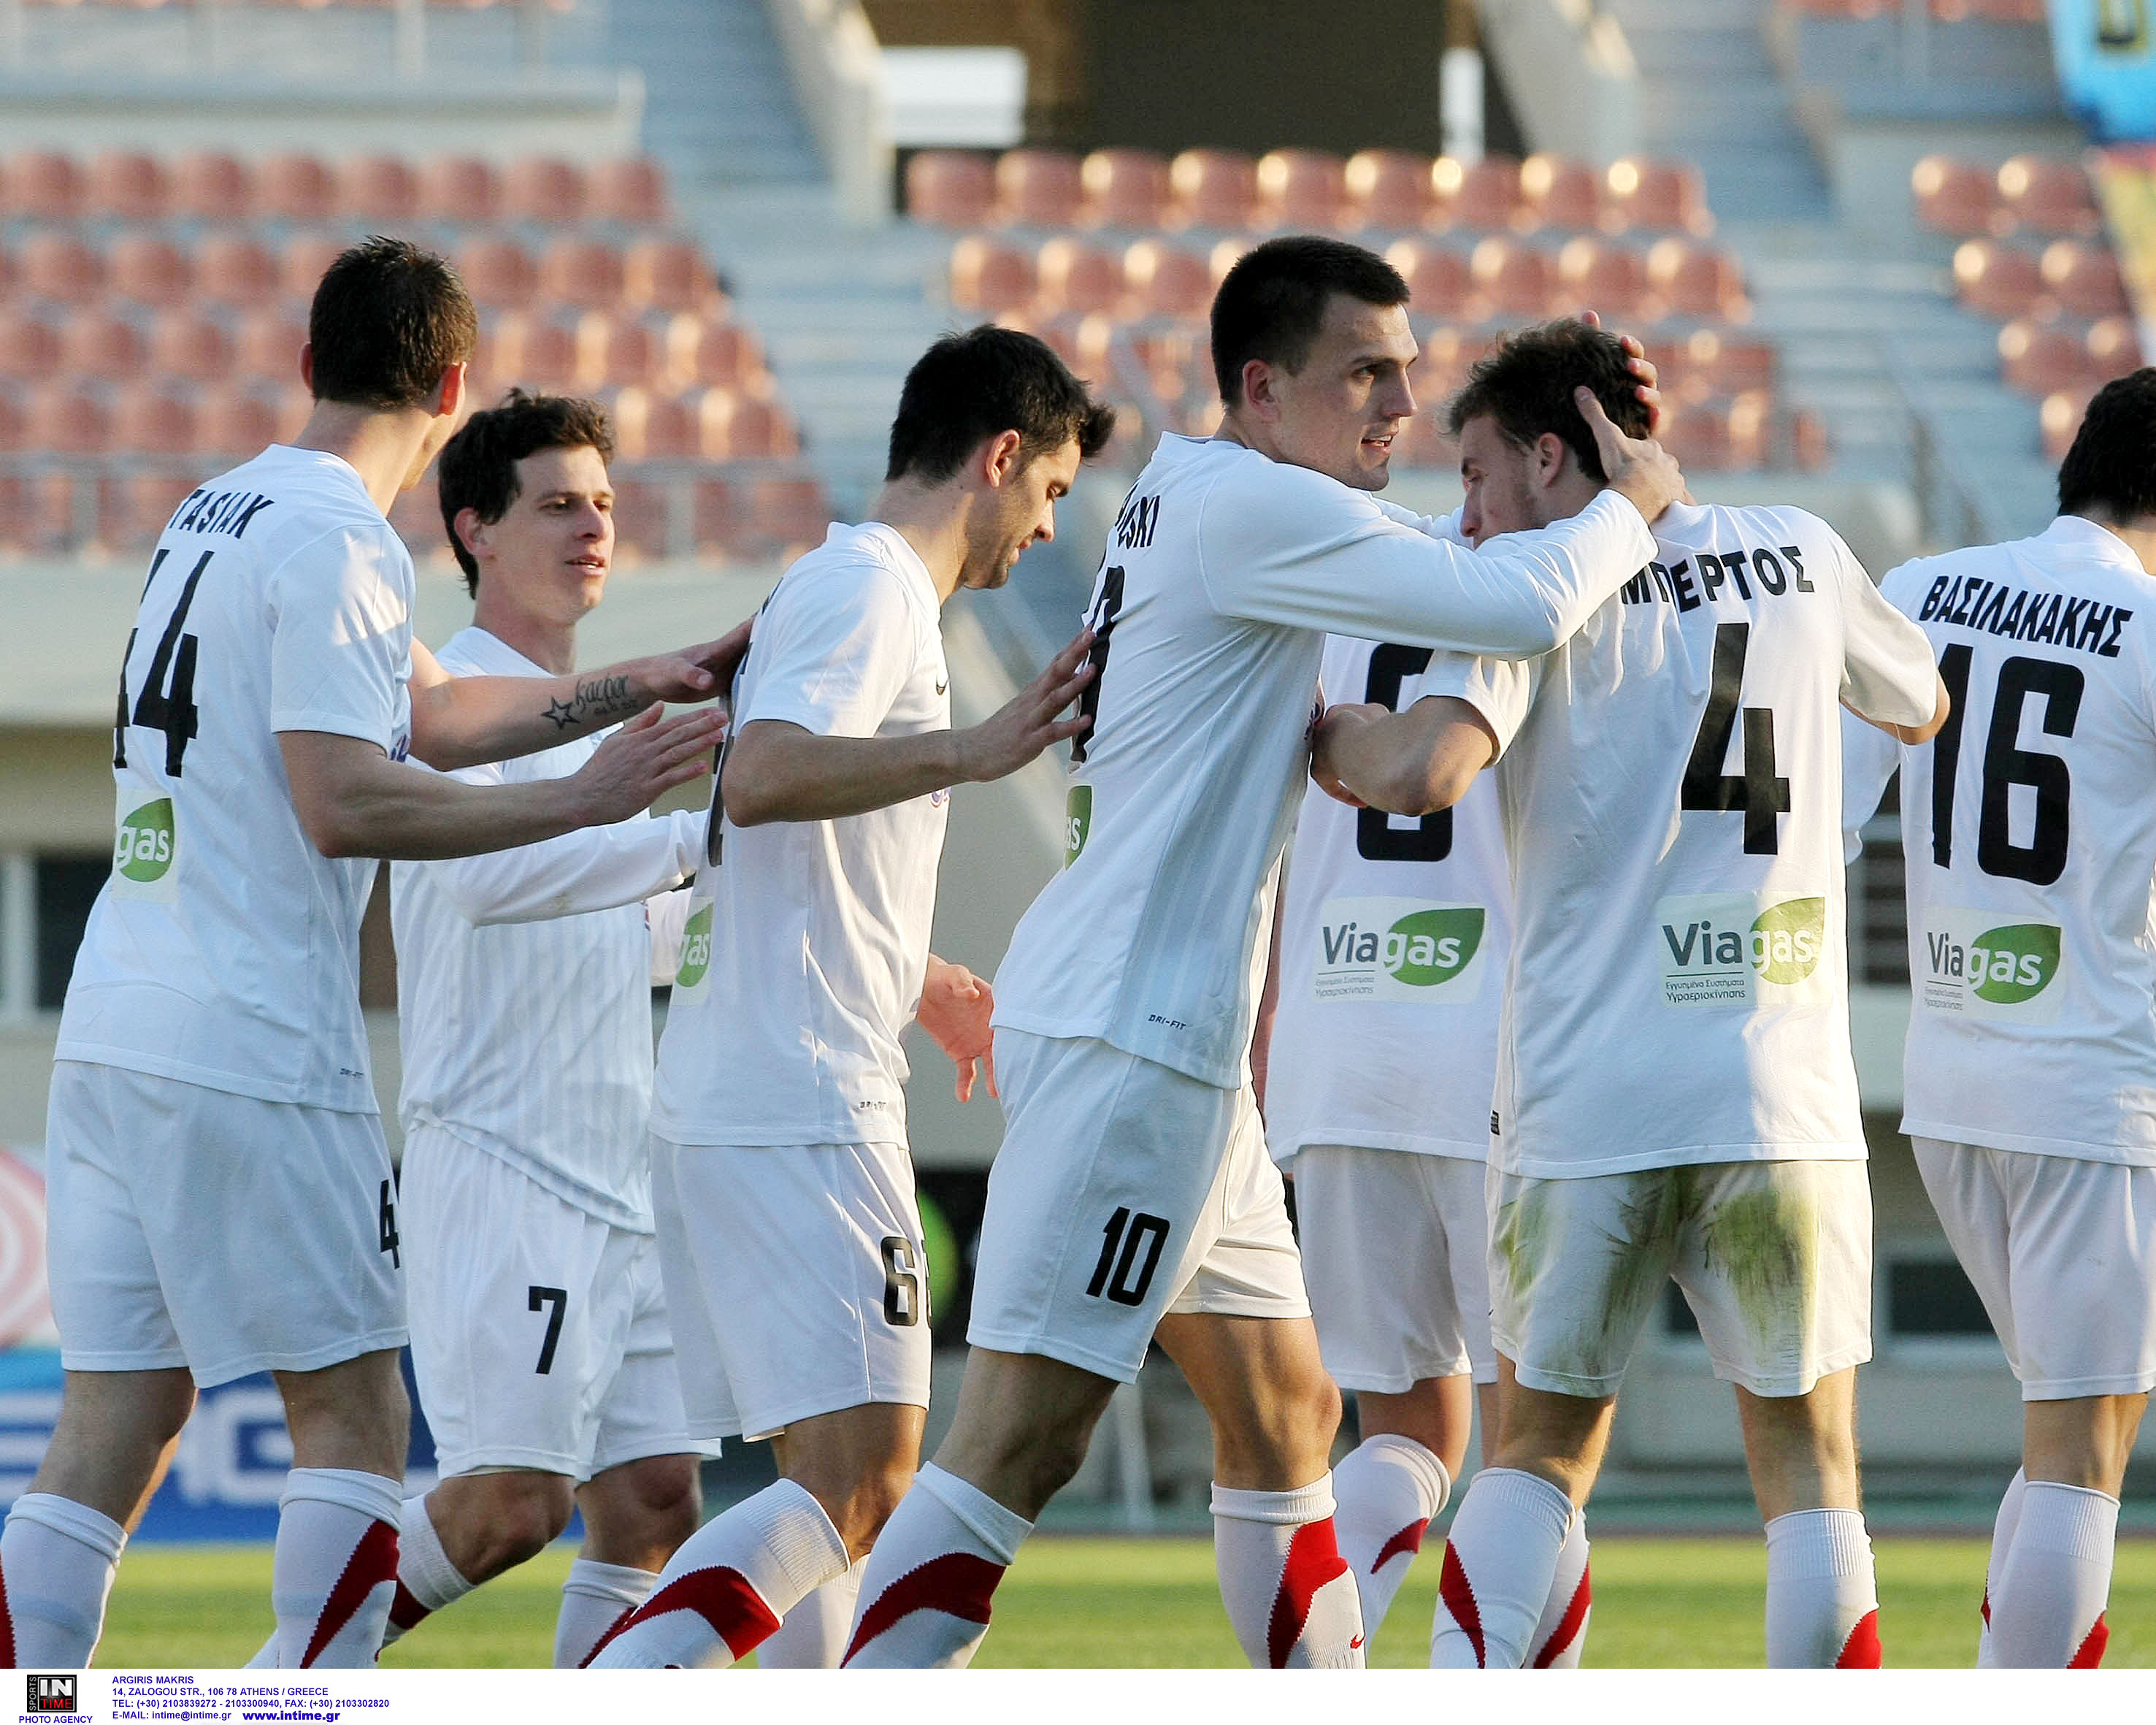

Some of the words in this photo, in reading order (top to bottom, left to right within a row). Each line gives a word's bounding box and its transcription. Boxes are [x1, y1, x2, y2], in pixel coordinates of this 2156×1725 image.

[1919, 575, 2134, 658] ΒΑΣΙΛΑΚΑΚΗΣ
[1681, 622, 1791, 855] 4
[1931, 643, 2085, 887] 16
[115, 825, 170, 869] gas
[1148, 1014, 1186, 1030] DRI-FIT
[1086, 1206, 1170, 1307] 10
[529, 1285, 567, 1374] 7
